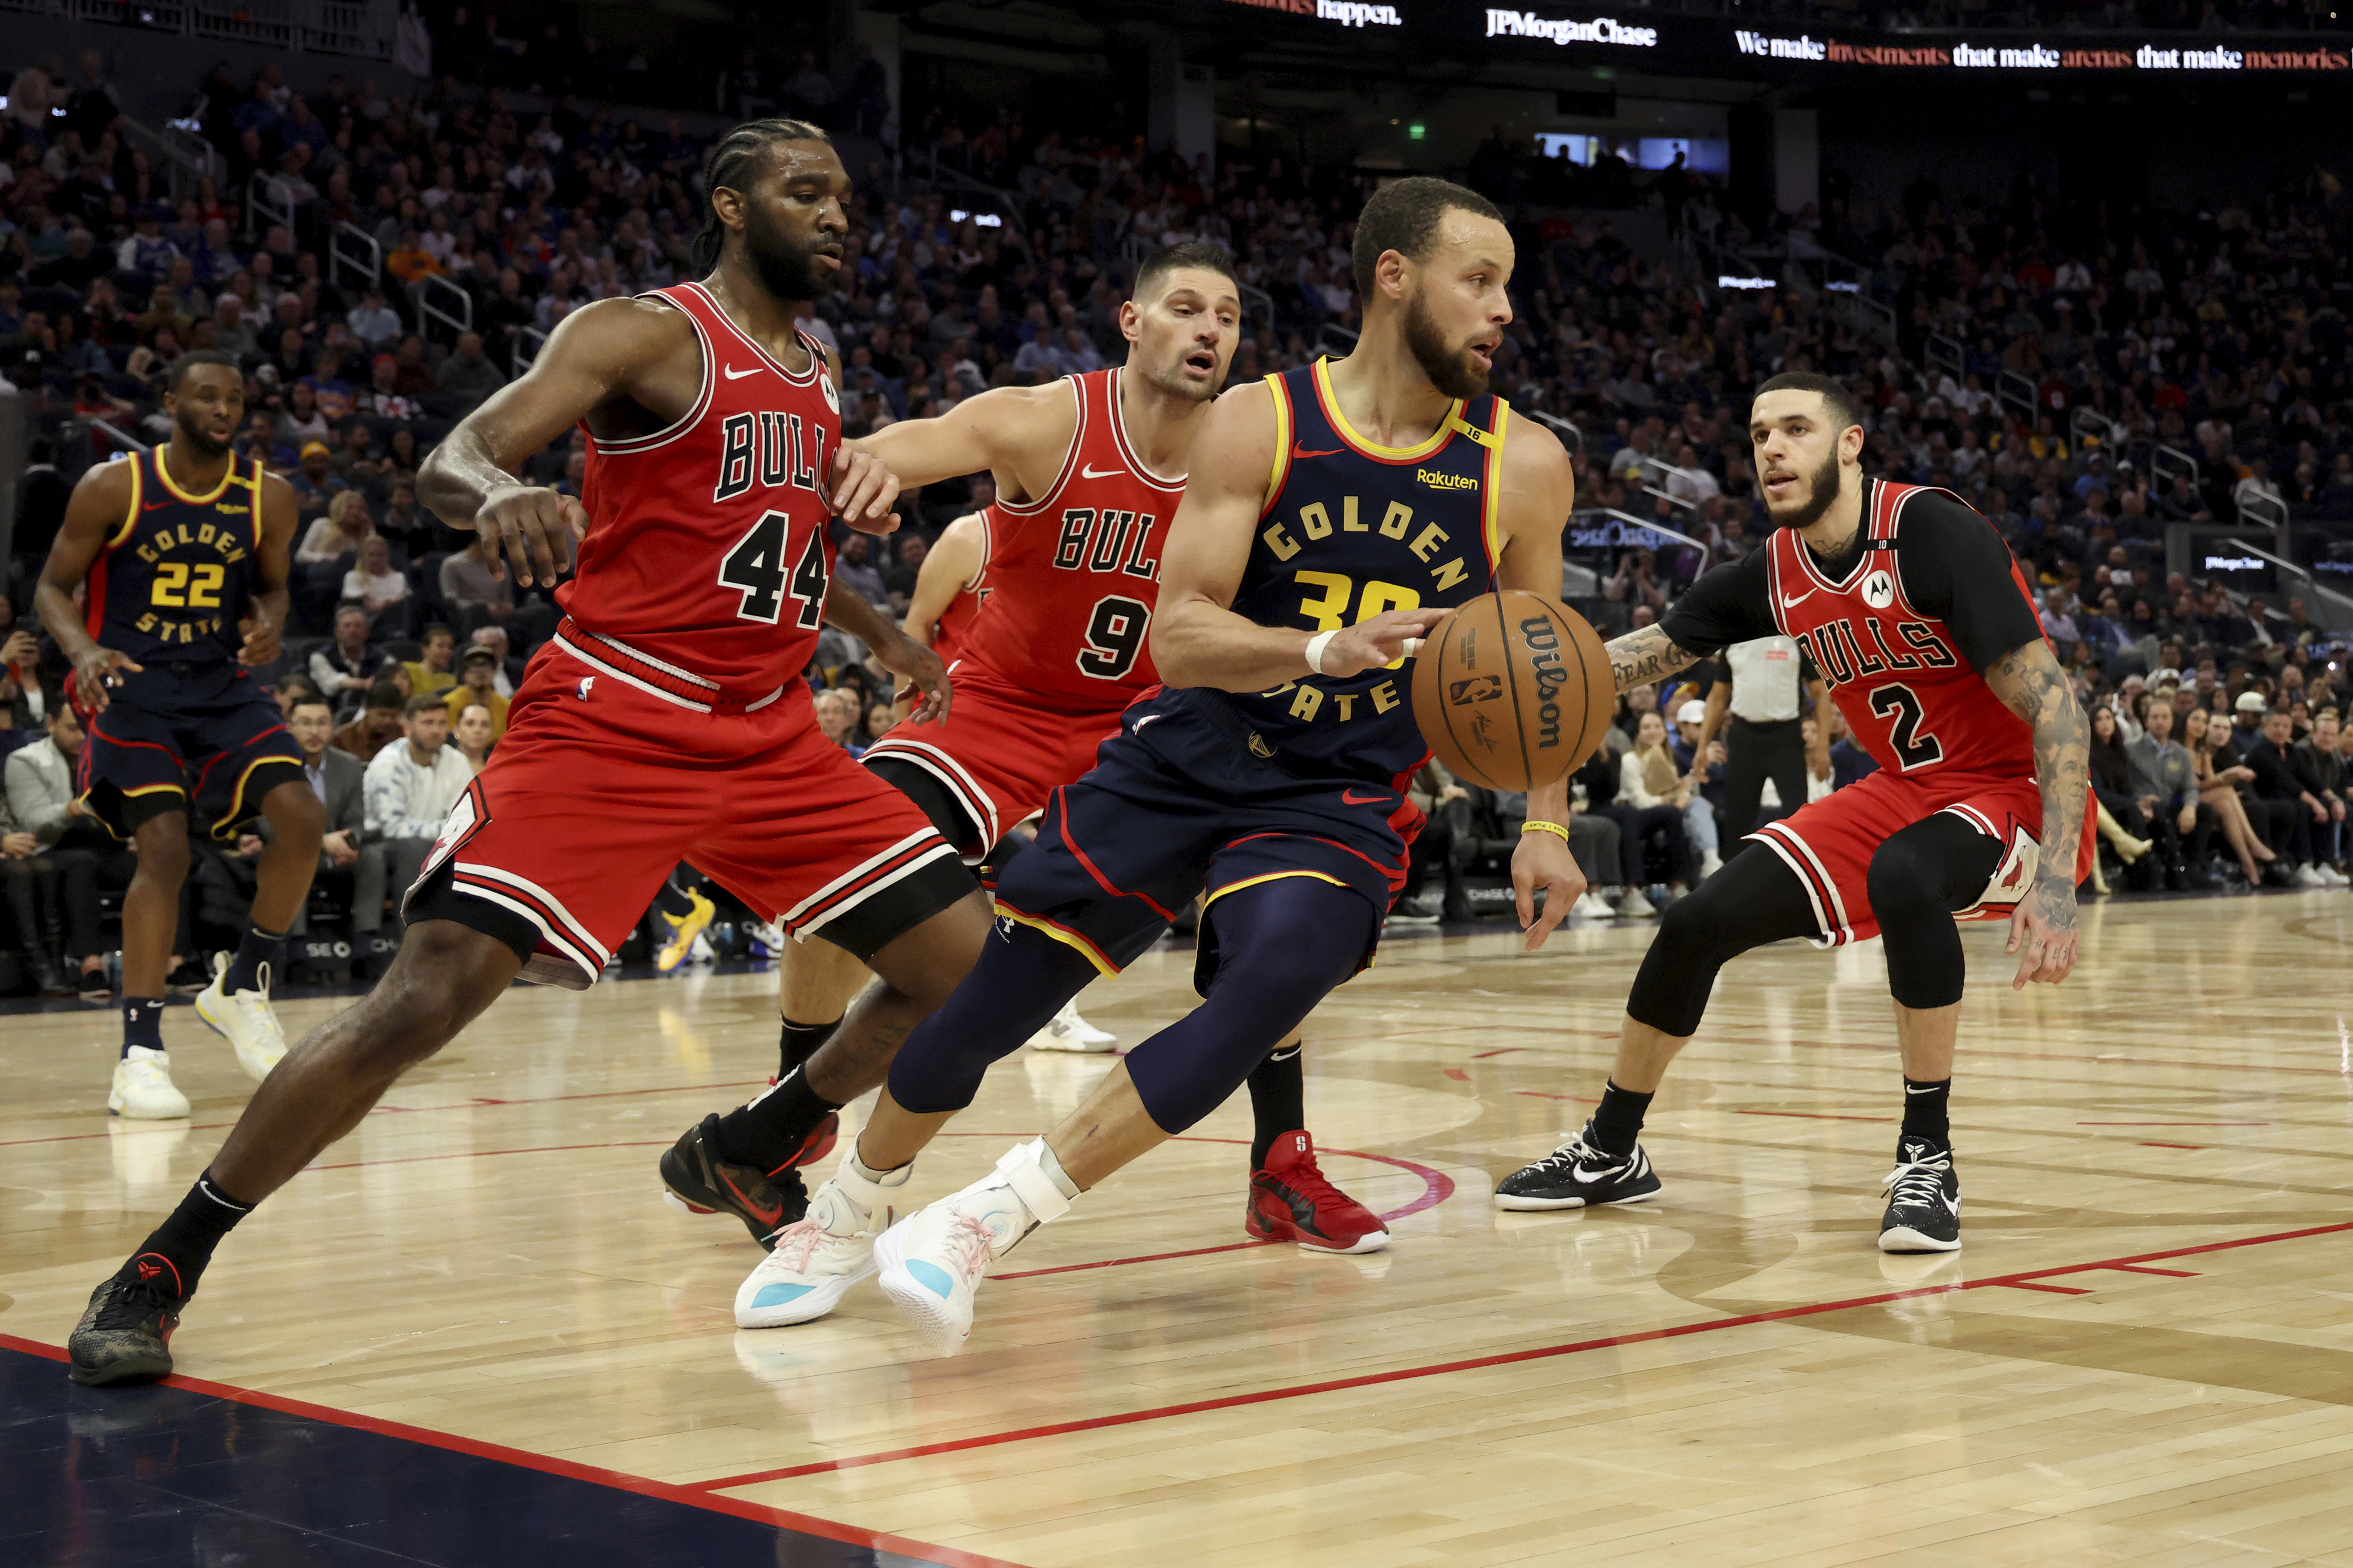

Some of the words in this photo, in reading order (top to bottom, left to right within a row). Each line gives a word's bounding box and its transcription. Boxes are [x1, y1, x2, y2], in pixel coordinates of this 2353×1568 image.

[1485, 9, 1657, 46] JPMorganChase
[1735, 30, 1768, 55] We
[1770, 35, 1825, 61] make
[1828, 38, 1950, 65] investments
[1953, 42, 1997, 67] that
[1999, 43, 2060, 68] make
[2137, 44, 2180, 68] that
[2182, 45, 2243, 69] make
[2245, 46, 2349, 69] memories
[713, 411, 838, 511] BULL
[1467, 426, 1481, 440] 16
[1417, 468, 1478, 491] Rakuten
[136, 523, 247, 563] GOLDEN
[716, 509, 830, 631] 44
[1052, 507, 1161, 584] BUL
[1263, 496, 1469, 592] GOLDEN
[1878, 539, 1887, 550] 10
[151, 562, 225, 609] 22
[1075, 594, 1152, 681] 9
[1519, 614, 1569, 750] Wilson
[1868, 681, 1944, 772] 2
